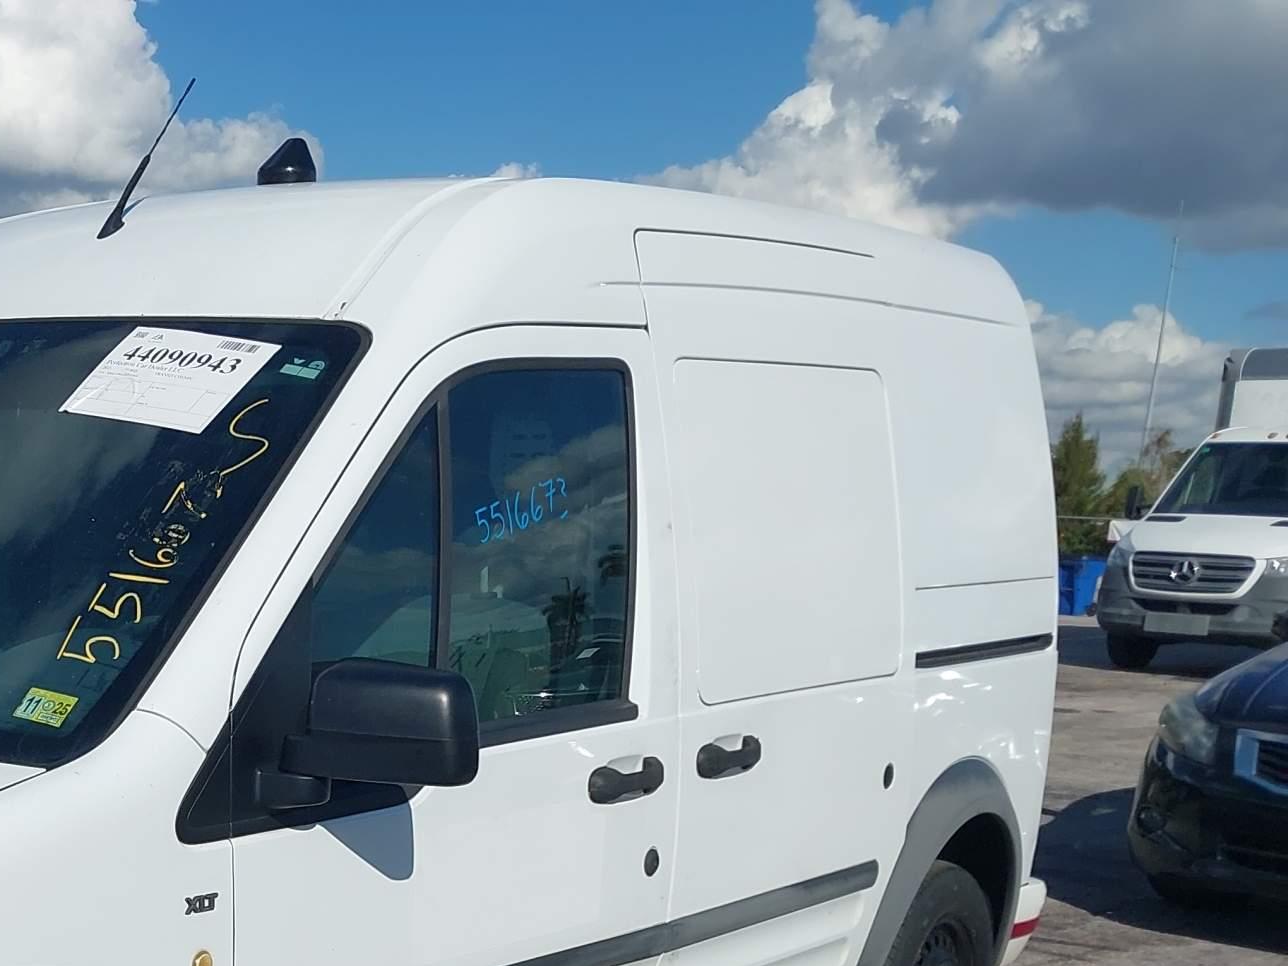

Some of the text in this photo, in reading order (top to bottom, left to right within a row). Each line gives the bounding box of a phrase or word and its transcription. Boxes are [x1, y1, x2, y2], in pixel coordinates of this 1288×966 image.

[123, 345, 242, 374] 44090943
[51, 701, 72, 716] 25
[184, 892, 219, 915] XLT
